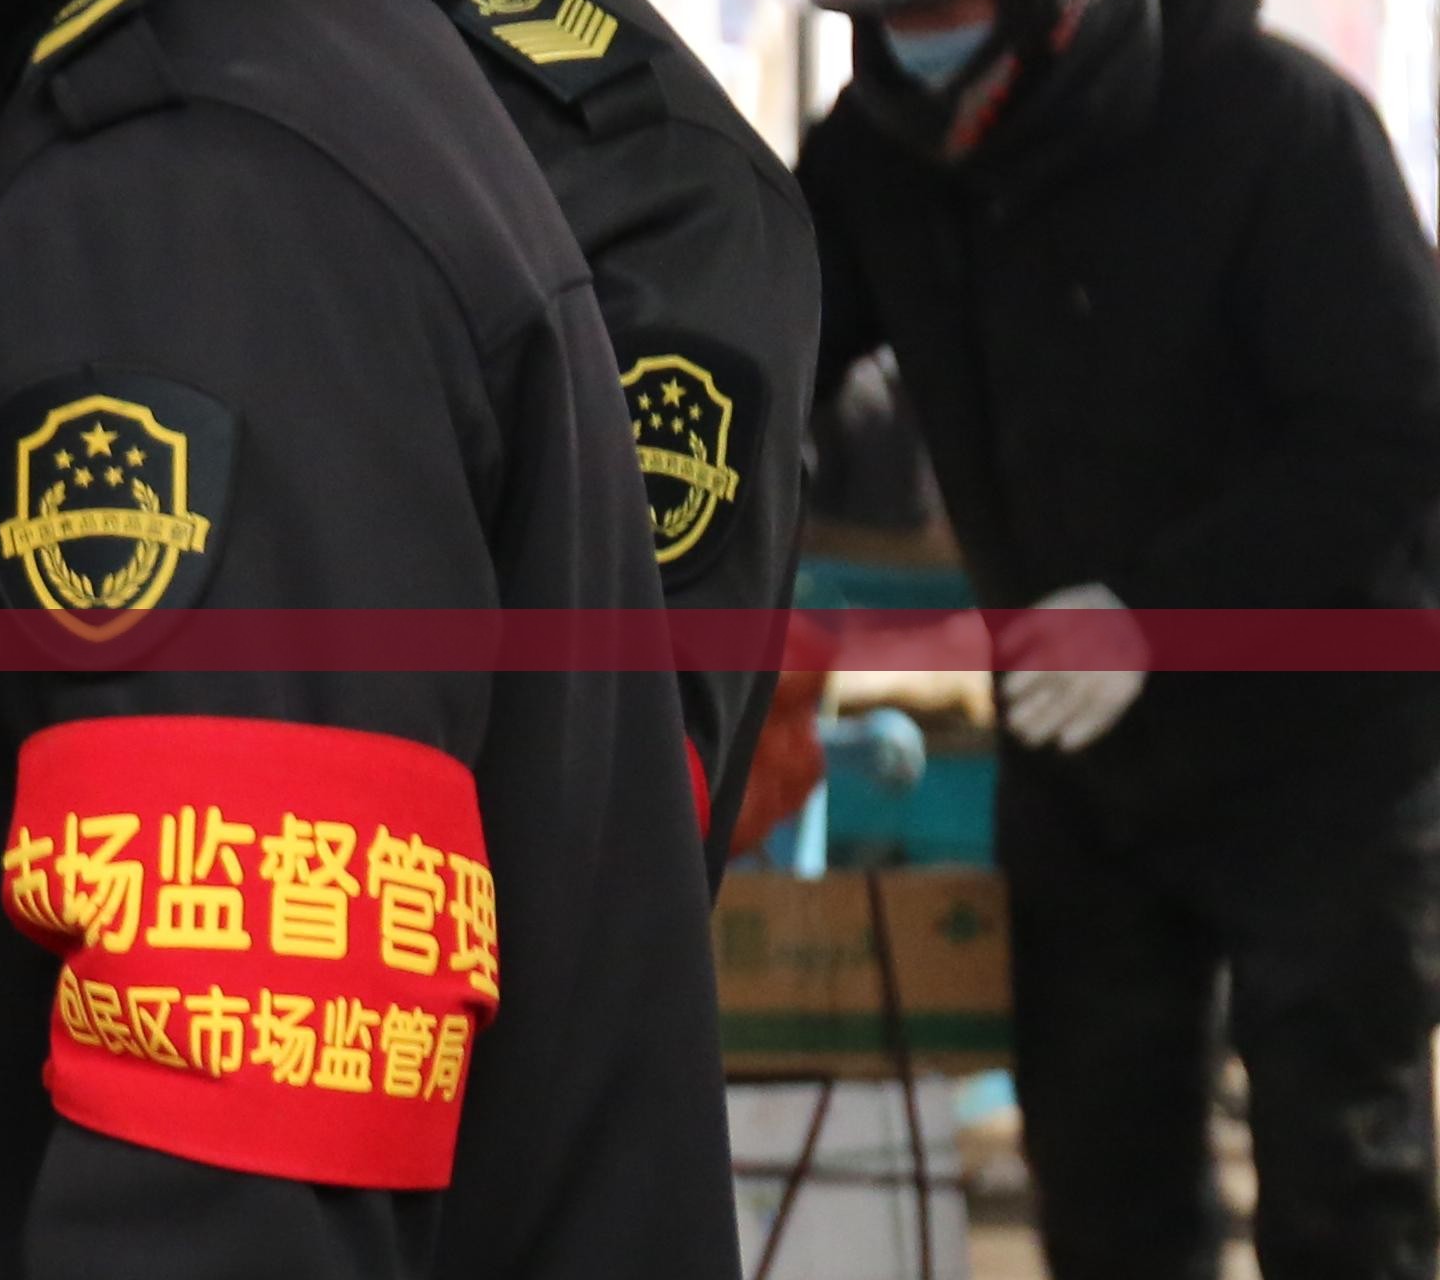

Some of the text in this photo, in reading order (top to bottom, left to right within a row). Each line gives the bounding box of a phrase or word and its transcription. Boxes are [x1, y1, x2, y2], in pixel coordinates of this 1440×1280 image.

[58, 963, 470, 1103] 回民区市场监管局
